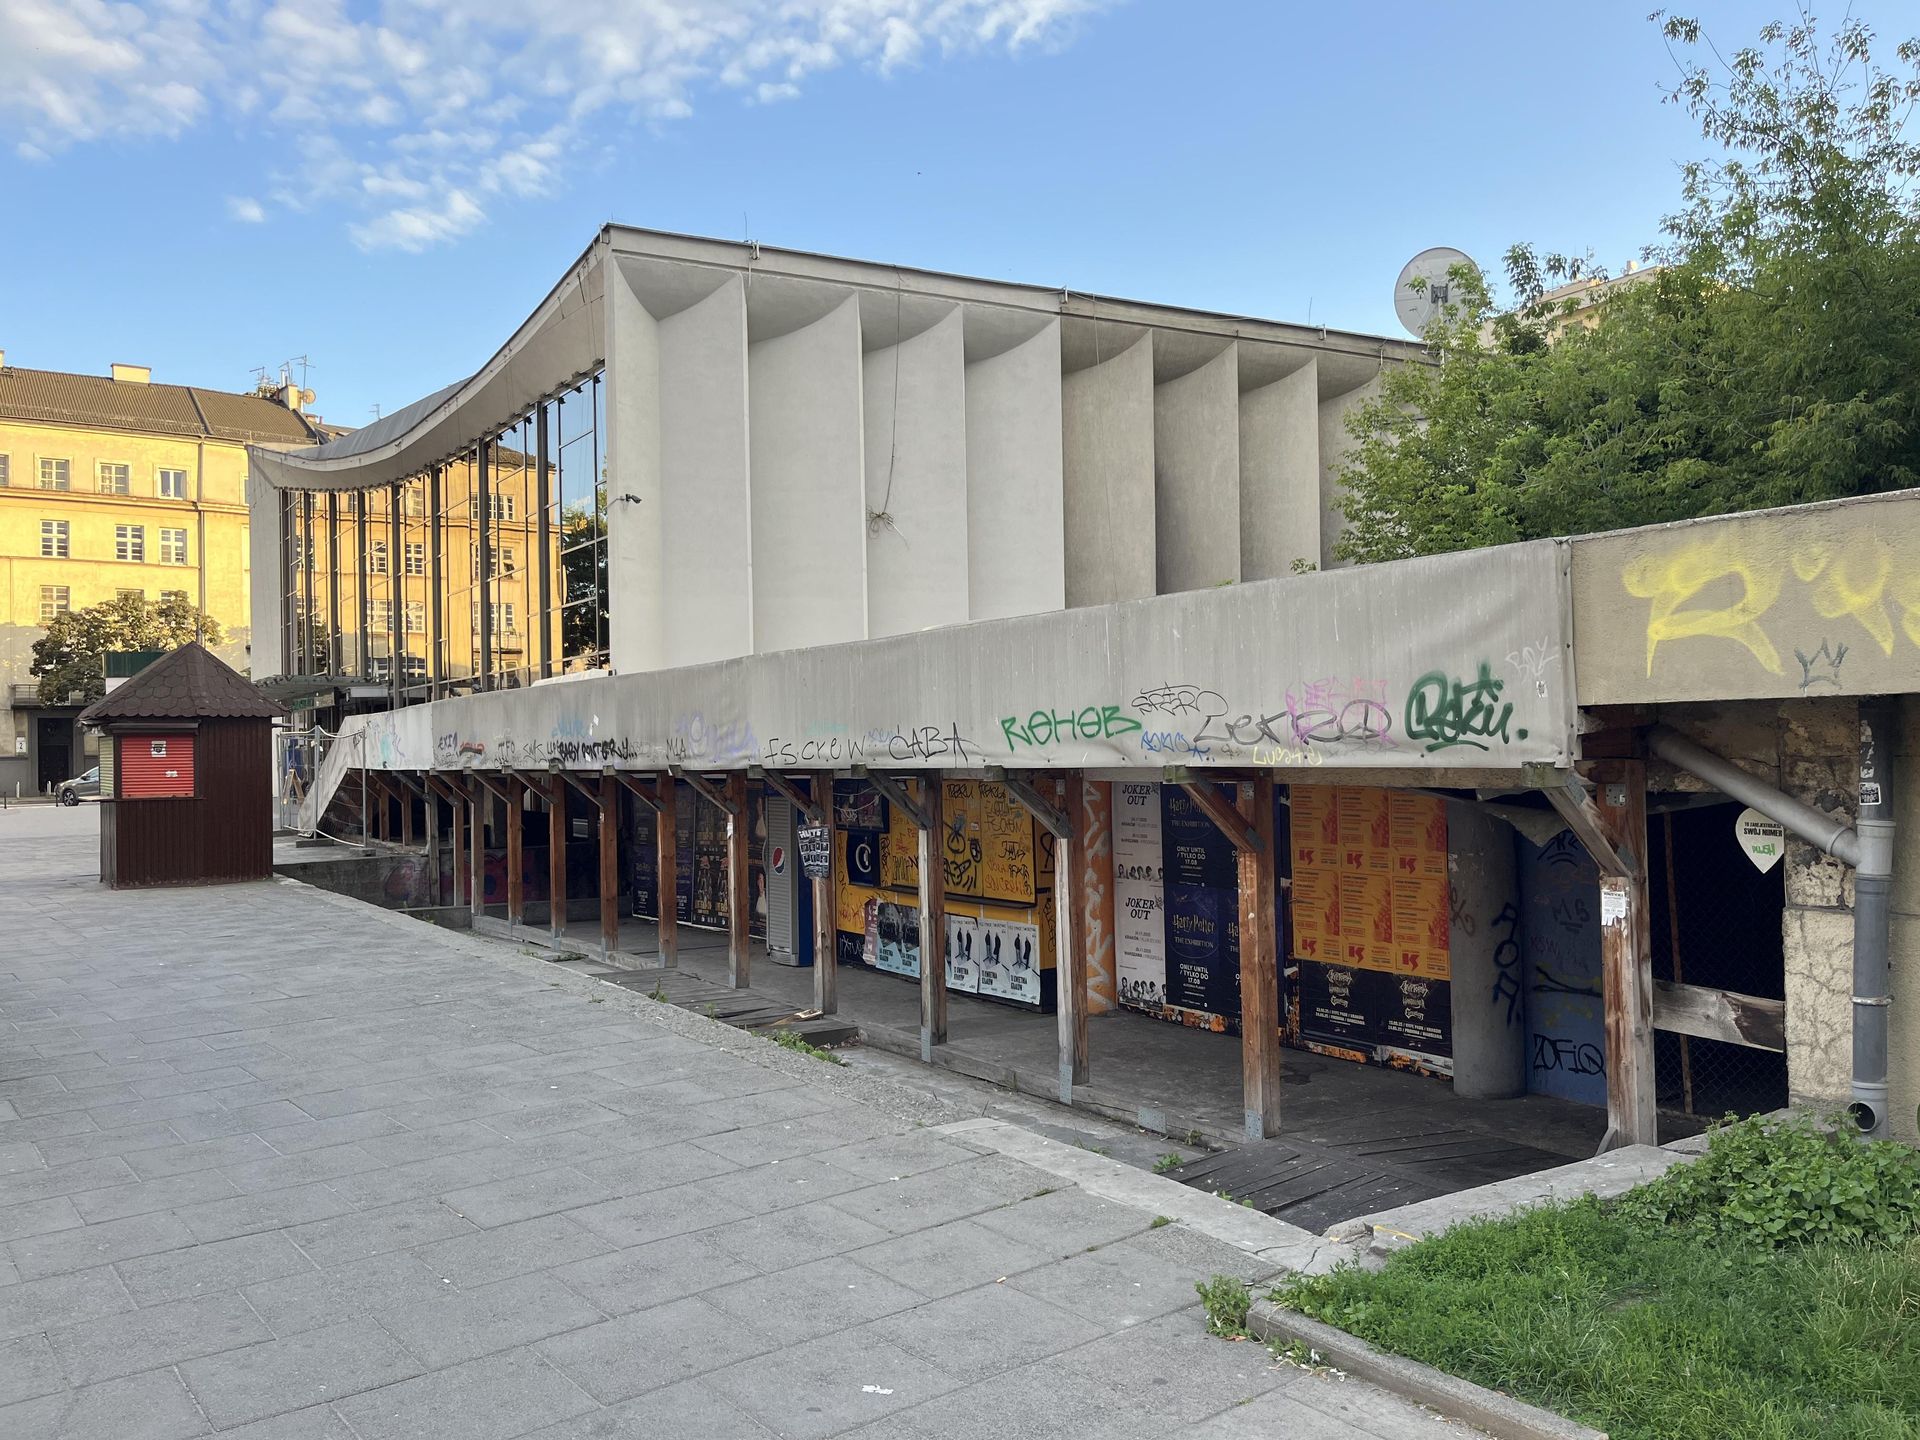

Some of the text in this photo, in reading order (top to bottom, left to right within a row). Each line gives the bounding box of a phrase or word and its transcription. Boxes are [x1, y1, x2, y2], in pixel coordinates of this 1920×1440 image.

[1122, 784, 1151, 795] JOKER
[1127, 795, 1147, 806] OUT
[1762, 829, 1783, 837] NUMER
[1126, 897, 1155, 909] JOKER
[1130, 909, 1151, 920] OUT
[1173, 914, 1215, 935] Harry Potter
[1174, 937, 1214, 948] THE EXHIBITION
[1179, 963, 1209, 974] ONLY UNTIL
[1183, 970, 1200, 978] TYLKO
[1200, 972, 1209, 980] DO
